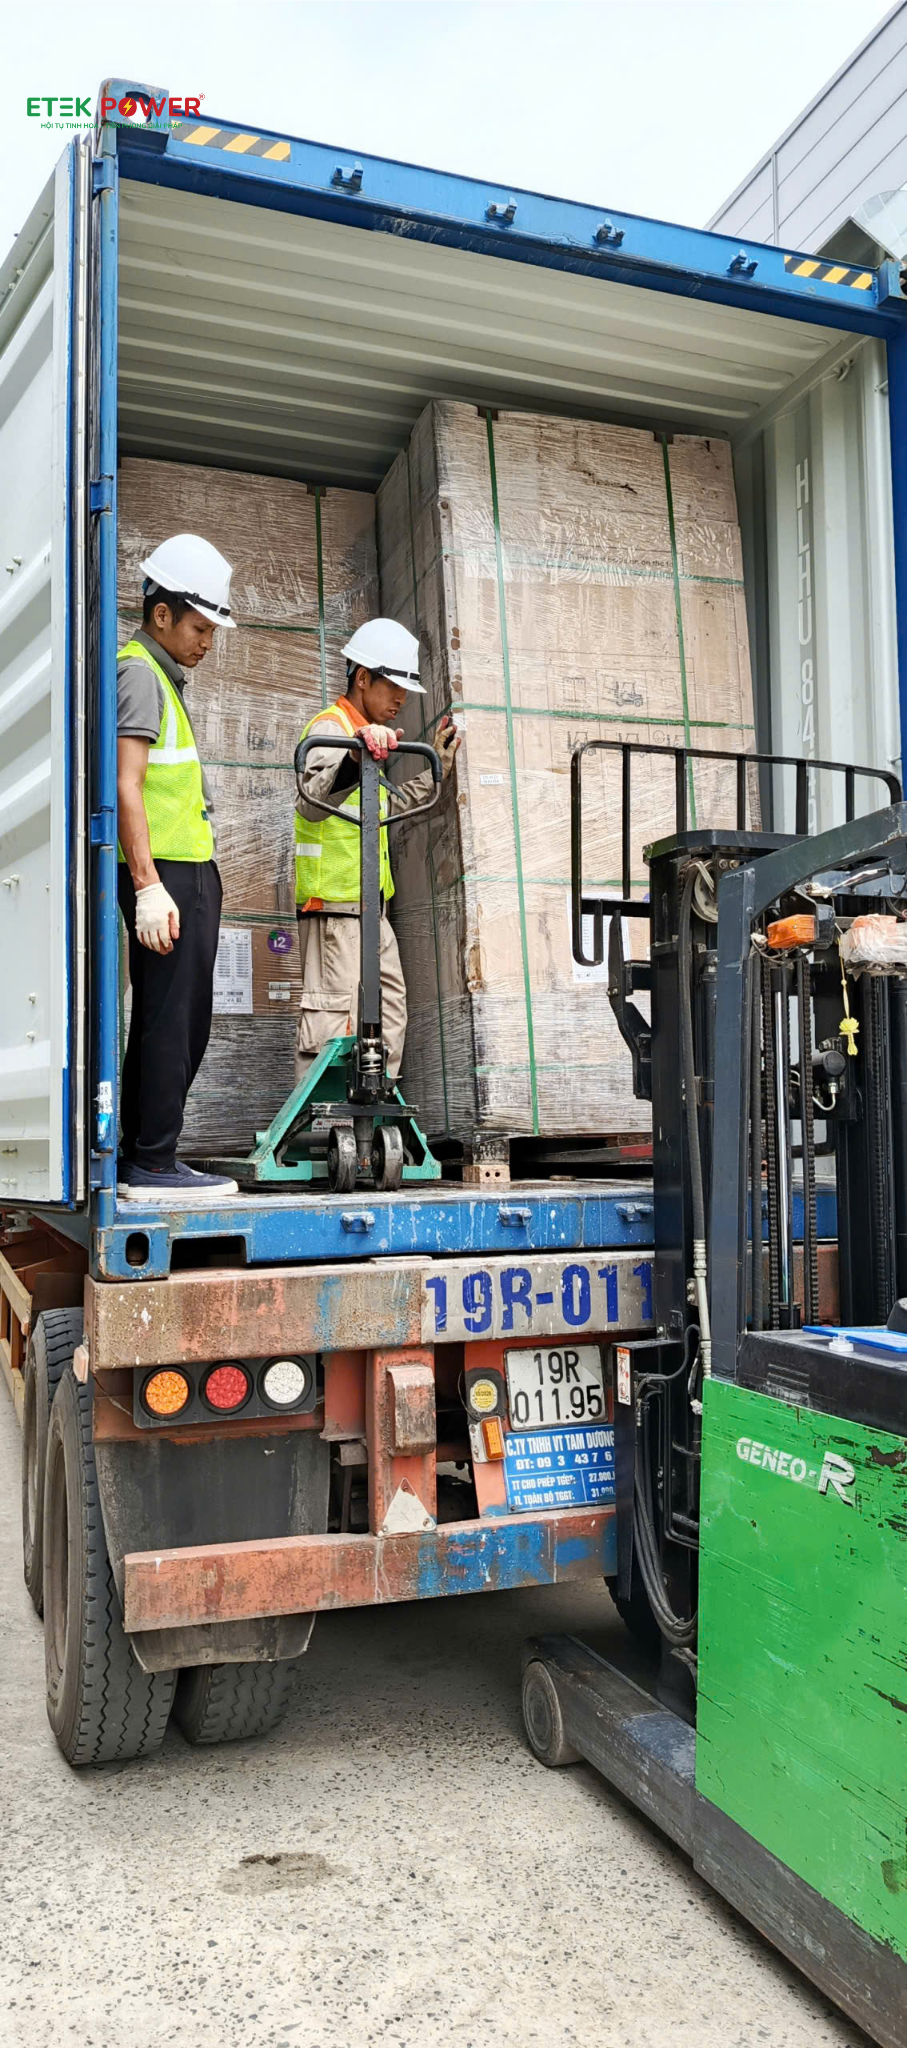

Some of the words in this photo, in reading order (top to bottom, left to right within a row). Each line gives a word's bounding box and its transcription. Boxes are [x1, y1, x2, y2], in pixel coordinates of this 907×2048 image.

[795, 457, 812, 645] HLHU
[425, 1261, 654, 1335] 19R-011
[534, 1350, 580, 1385] 19R
[514, 1385, 603, 1424] 011.95
[506, 1438, 526, 1456] C.TY
[526, 1436, 552, 1454] TNHH
[552, 1434, 564, 1452] VT
[564, 1433, 585, 1451] TAM
[536, 1456, 552, 1468] 09
[557, 1455, 566, 1467] 3
[574, 1453, 589, 1465] 43
[592, 1452, 599, 1463] 7
[604, 1450, 613, 1462] 6
[511, 1480, 521, 1491] TT
[521, 1478, 536, 1490] CHO
[536, 1475, 556, 1488] PHÉP
[543, 1490, 554, 1504] BỘ
[554, 1490, 576, 1501] TGGT:
